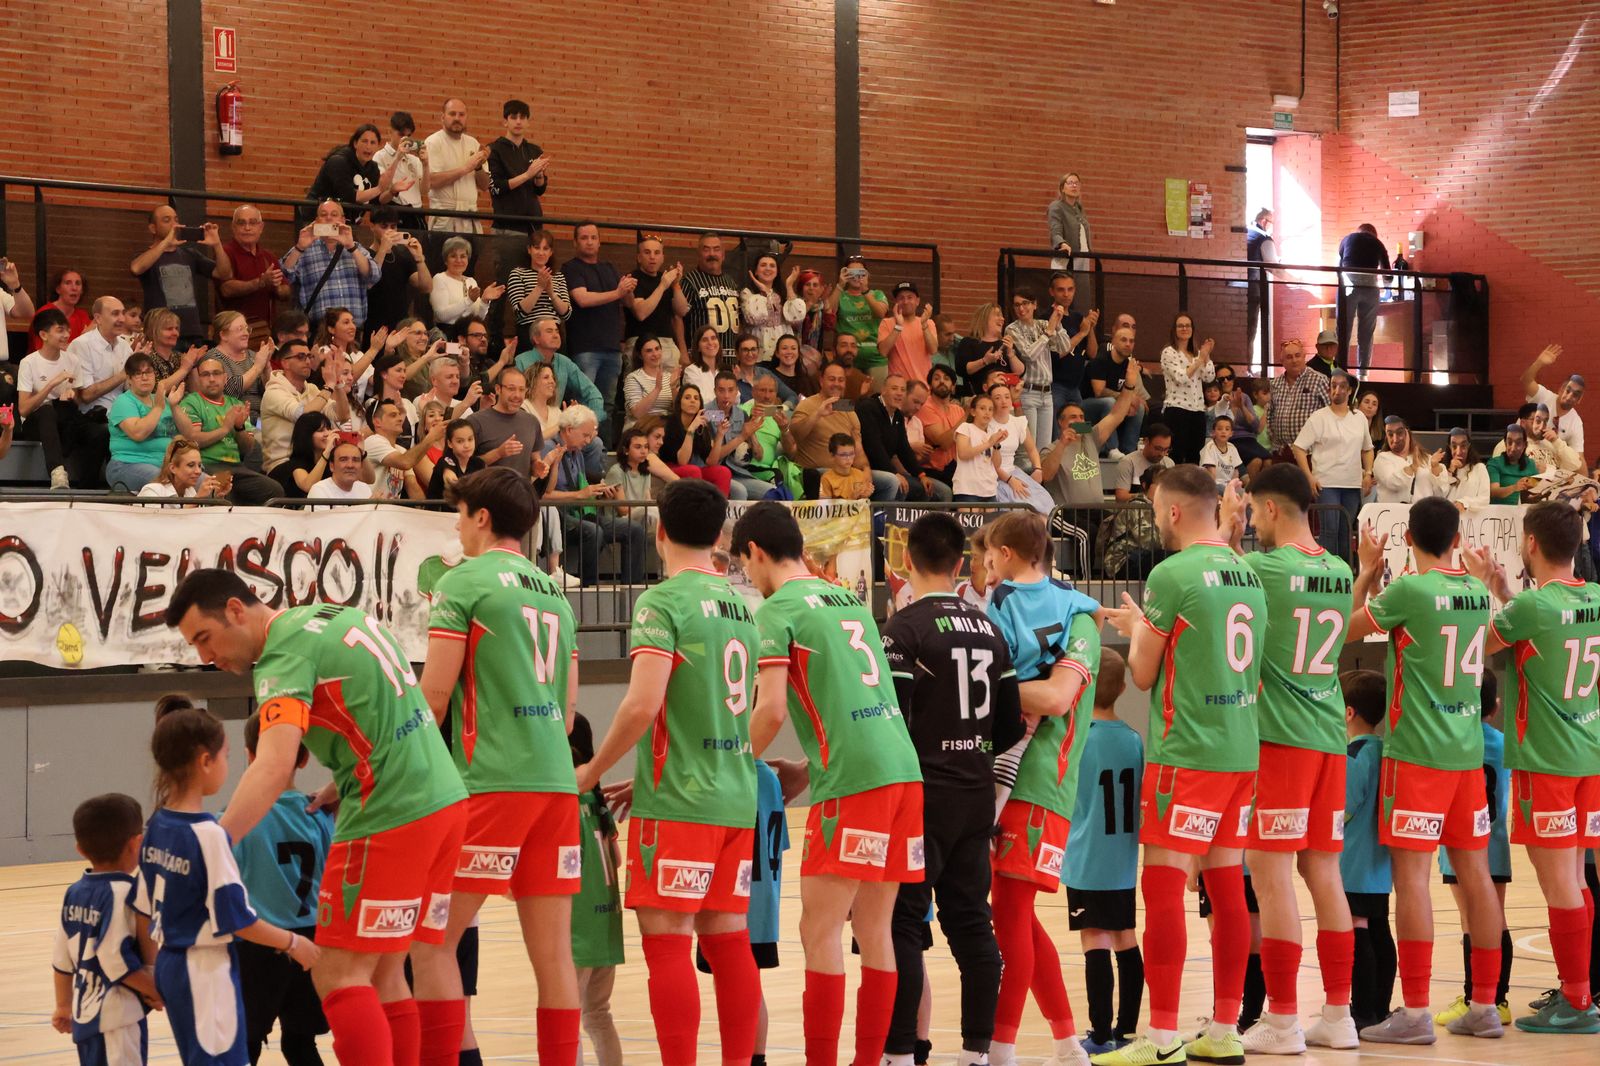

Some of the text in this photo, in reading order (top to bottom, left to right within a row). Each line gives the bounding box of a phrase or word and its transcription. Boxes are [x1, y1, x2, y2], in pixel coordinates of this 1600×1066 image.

[791, 504, 823, 520] TODO
[896, 507, 909, 522] EL
[1460, 517, 1476, 549] NA
[82, 526, 403, 641] VESCO!!
[313, 603, 345, 621] MIL
[1307, 576, 1352, 595] MILAR
[343, 616, 417, 697] 10
[521, 604, 560, 684] 17
[840, 620, 880, 687] 3
[951, 617, 995, 637] MILAR
[1226, 602, 1255, 673] 6
[1292, 607, 1345, 675] 12
[1440, 624, 1487, 688] 14
[723, 637, 749, 717] 9
[951, 647, 994, 719] 13
[1563, 636, 1600, 700] 15
[265, 703, 282, 722] C
[1098, 767, 1135, 835] 11
[277, 841, 316, 917] 7
